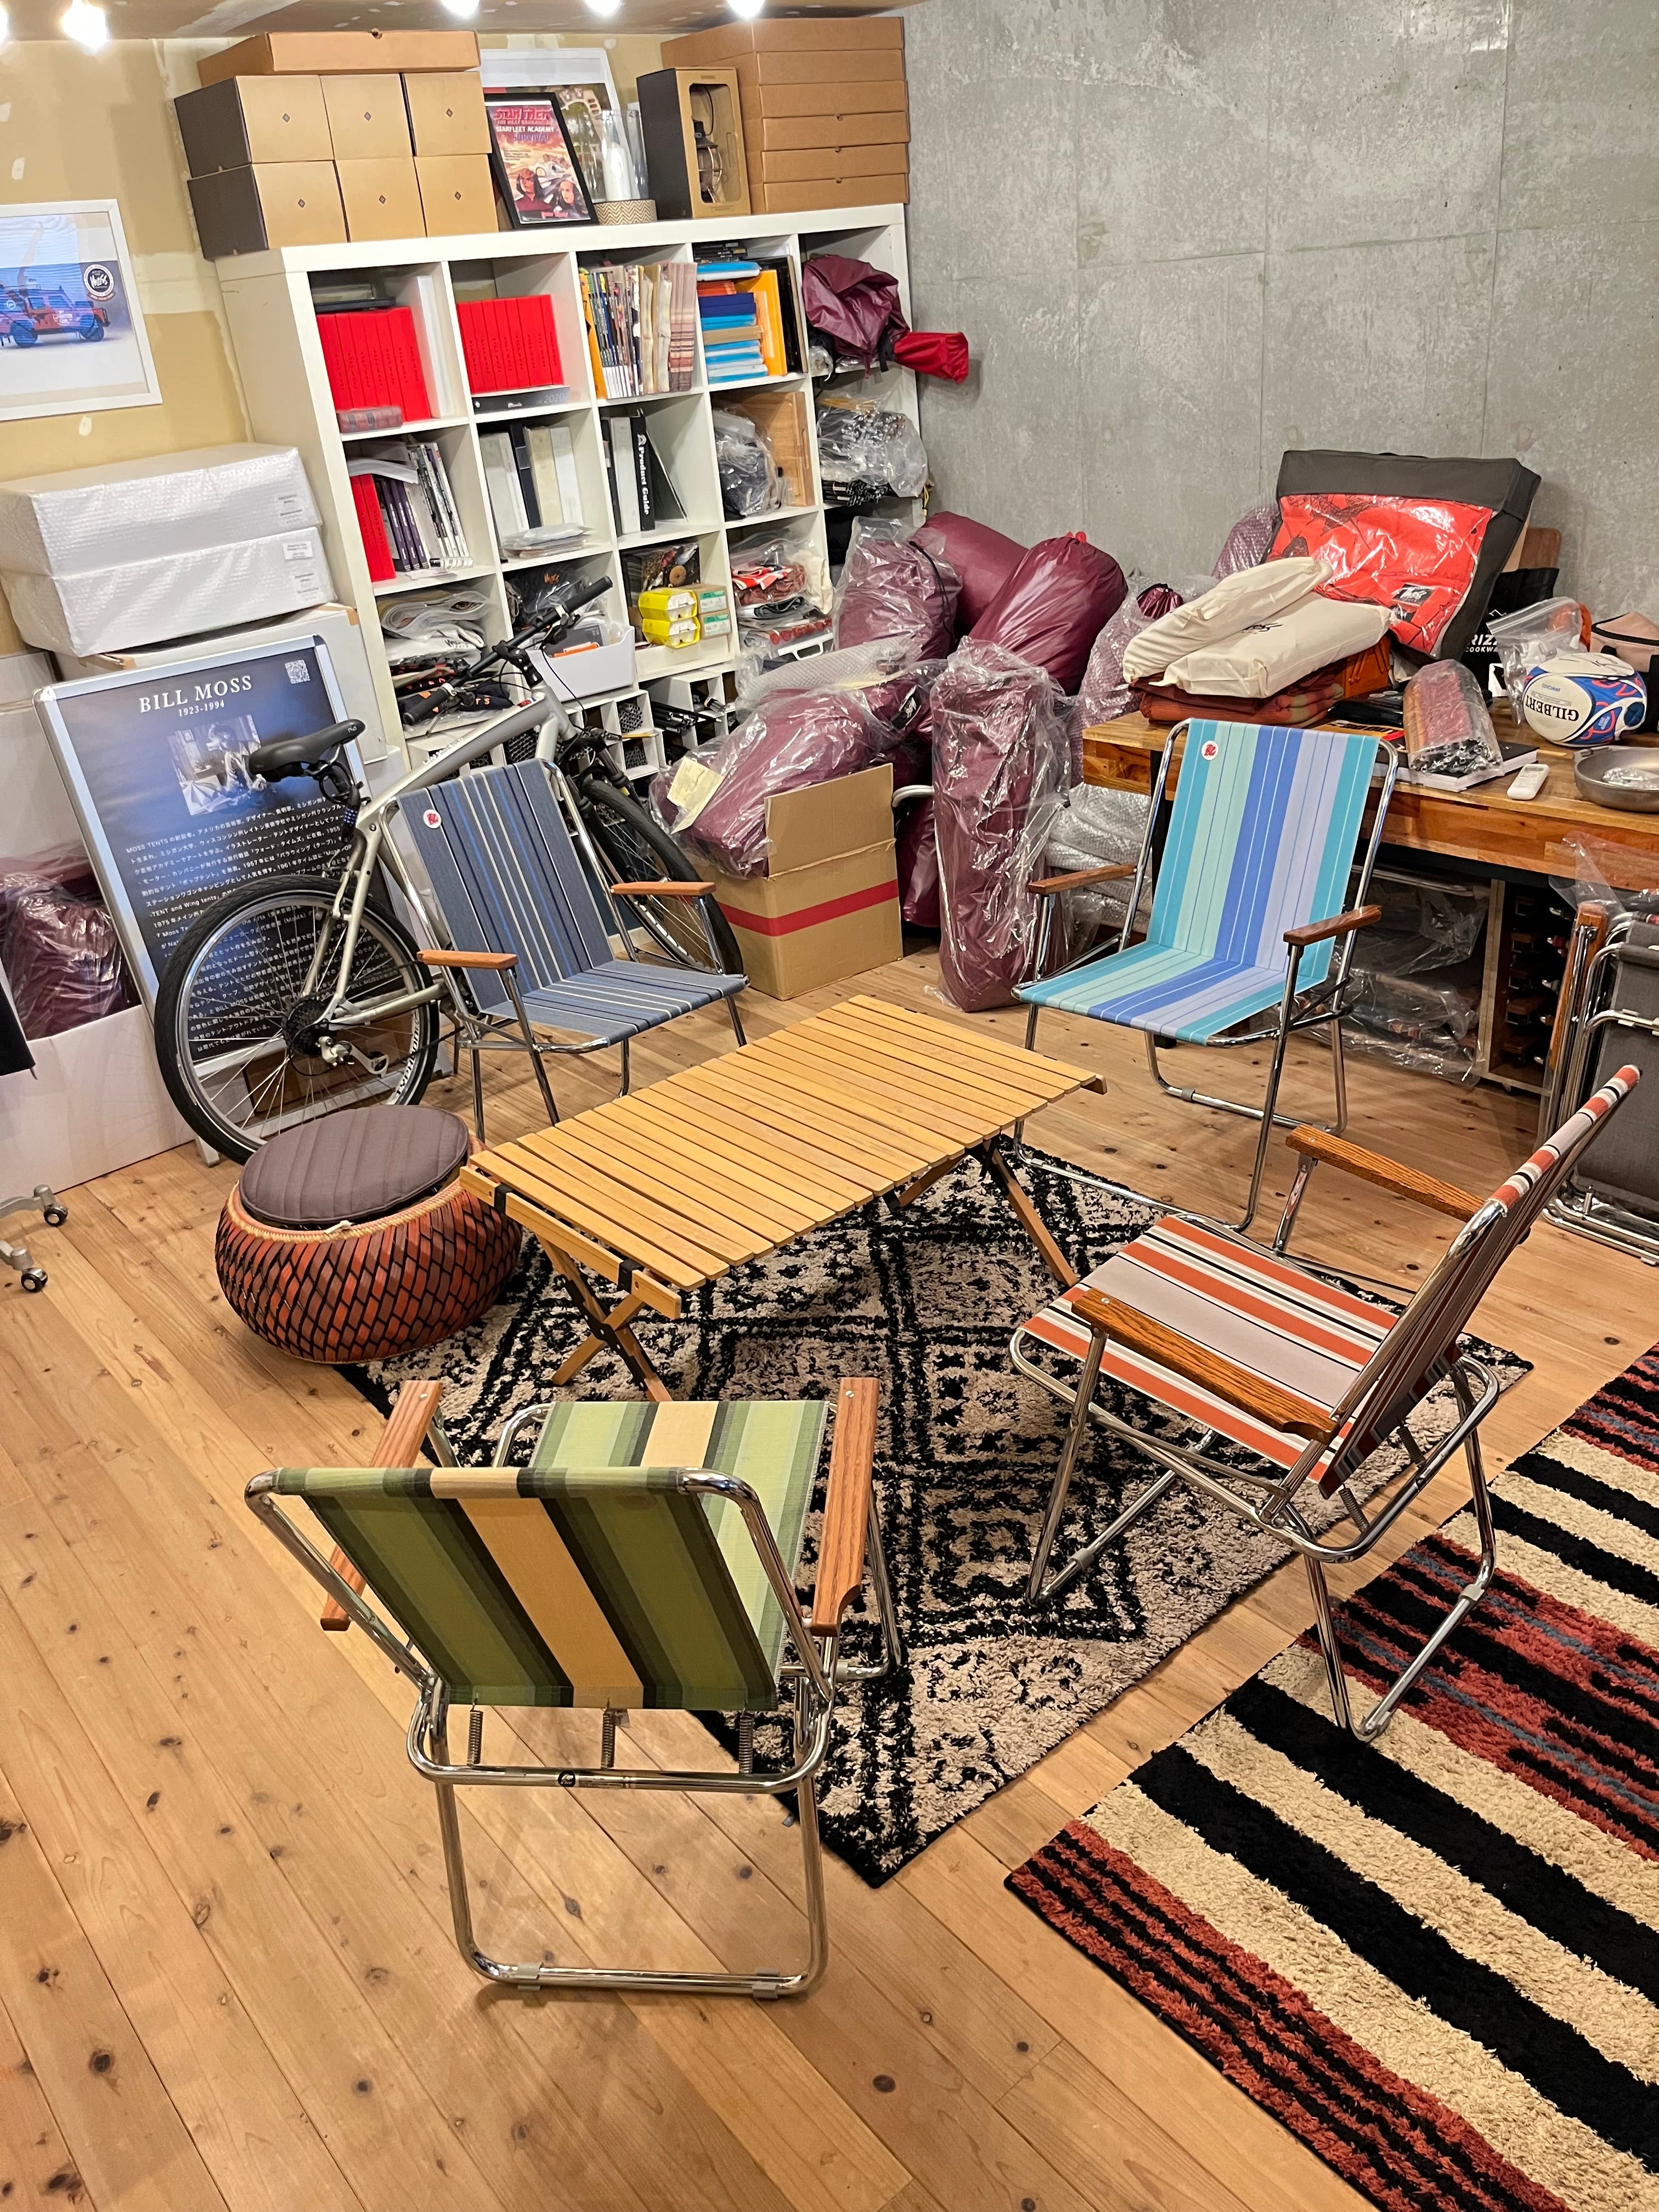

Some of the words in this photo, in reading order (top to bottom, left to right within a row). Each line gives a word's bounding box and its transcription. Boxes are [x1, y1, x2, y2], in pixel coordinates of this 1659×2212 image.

[638, 447, 647, 485] Product
[642, 487, 650, 515] Guide
[139, 690, 188, 713] BILL
[194, 675, 252, 701] MOSS
[178, 699, 225, 717] 1923-1994
[1525, 695, 1579, 722] GILBERT
[126, 845, 146, 854] MOSS
[147, 838, 168, 848] TENTS
[184, 898, 200, 907] Wing
